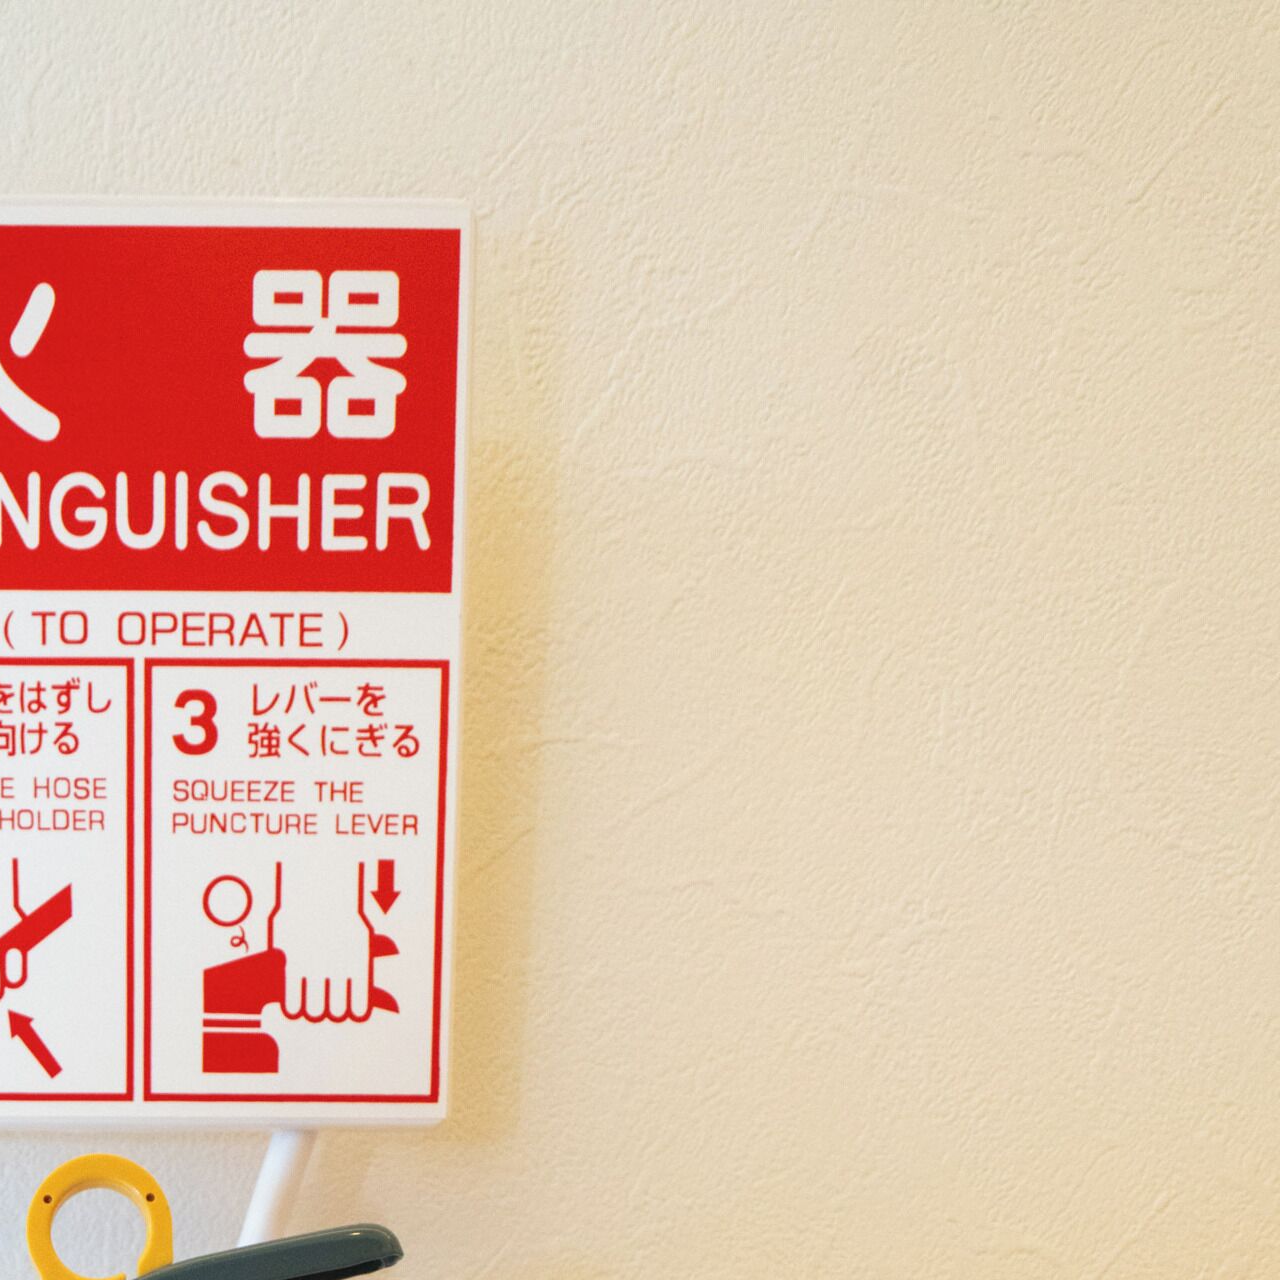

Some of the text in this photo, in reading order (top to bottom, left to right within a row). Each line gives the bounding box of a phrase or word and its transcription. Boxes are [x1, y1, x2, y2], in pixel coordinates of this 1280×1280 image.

[250, 681, 385, 716] レバーを
[172, 688, 219, 756] 3
[247, 721, 420, 758] 強くにぎる
[33, 776, 106, 800] HOSE
[173, 779, 363, 804] SQUEEZE THE
[0, 808, 105, 832] HOLDER
[172, 812, 418, 836] PUNCTURE LEVER
